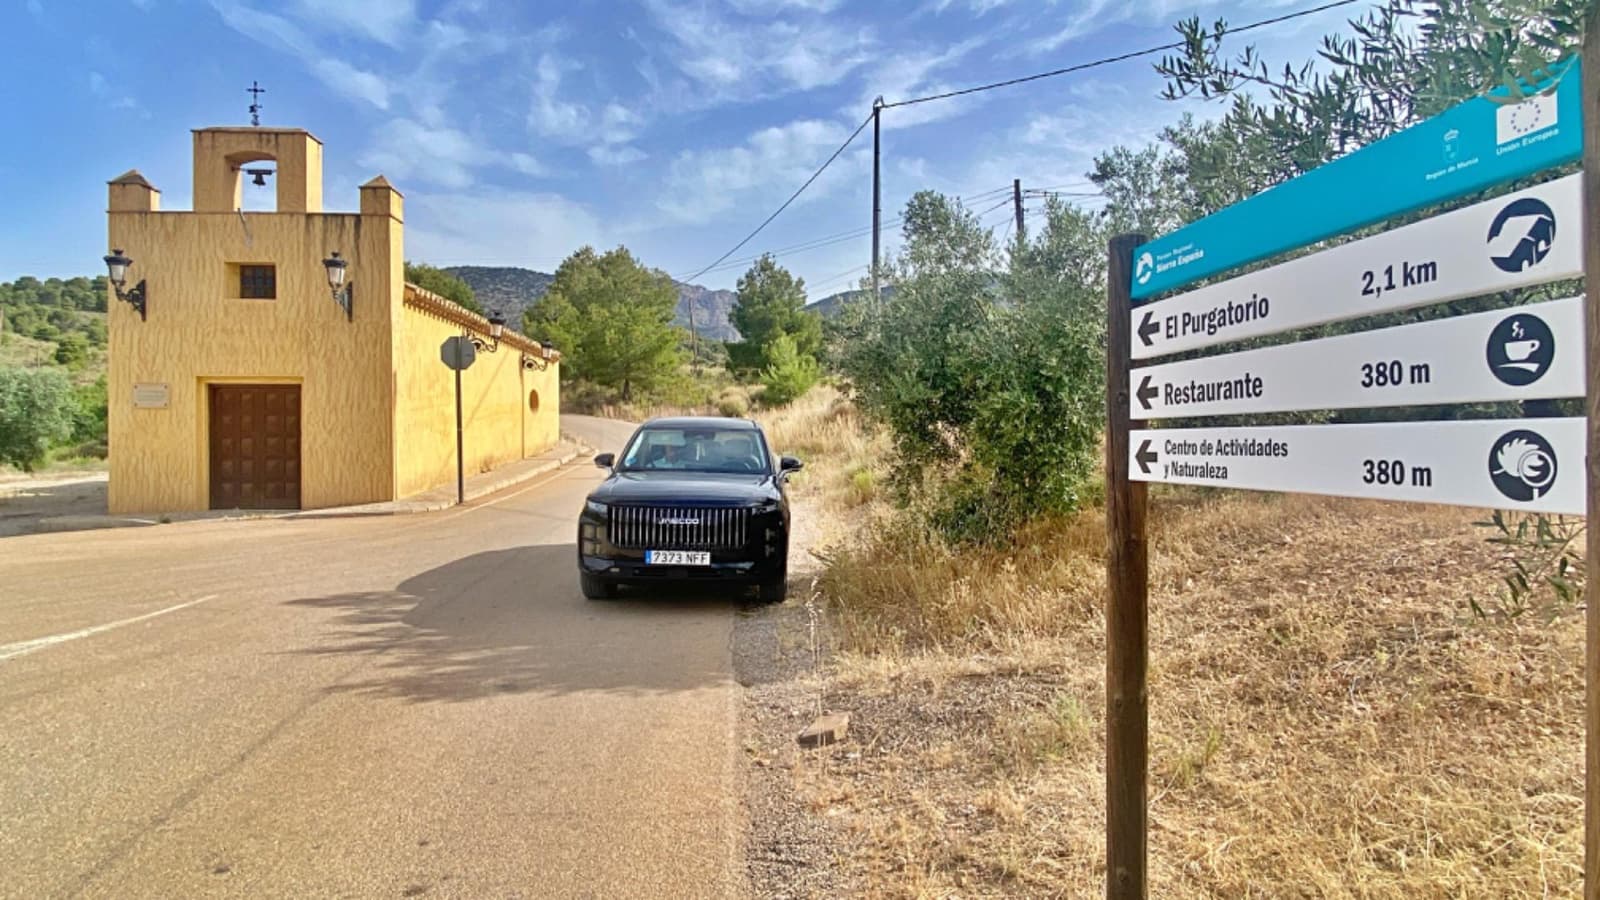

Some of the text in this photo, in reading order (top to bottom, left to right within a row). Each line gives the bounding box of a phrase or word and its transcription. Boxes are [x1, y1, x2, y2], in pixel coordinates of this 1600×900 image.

[1522, 128, 1559, 147] Europea
[1166, 261, 1437, 339] El Purgatorio 2,1 km
[1164, 360, 1430, 405] Restaurante 380 m
[1164, 437, 1289, 457] Centro de Actividades
[1164, 460, 1228, 480] y Naturaleza
[1362, 459, 1432, 487] 380 m
[653, 551, 708, 564] 7373 NFF
